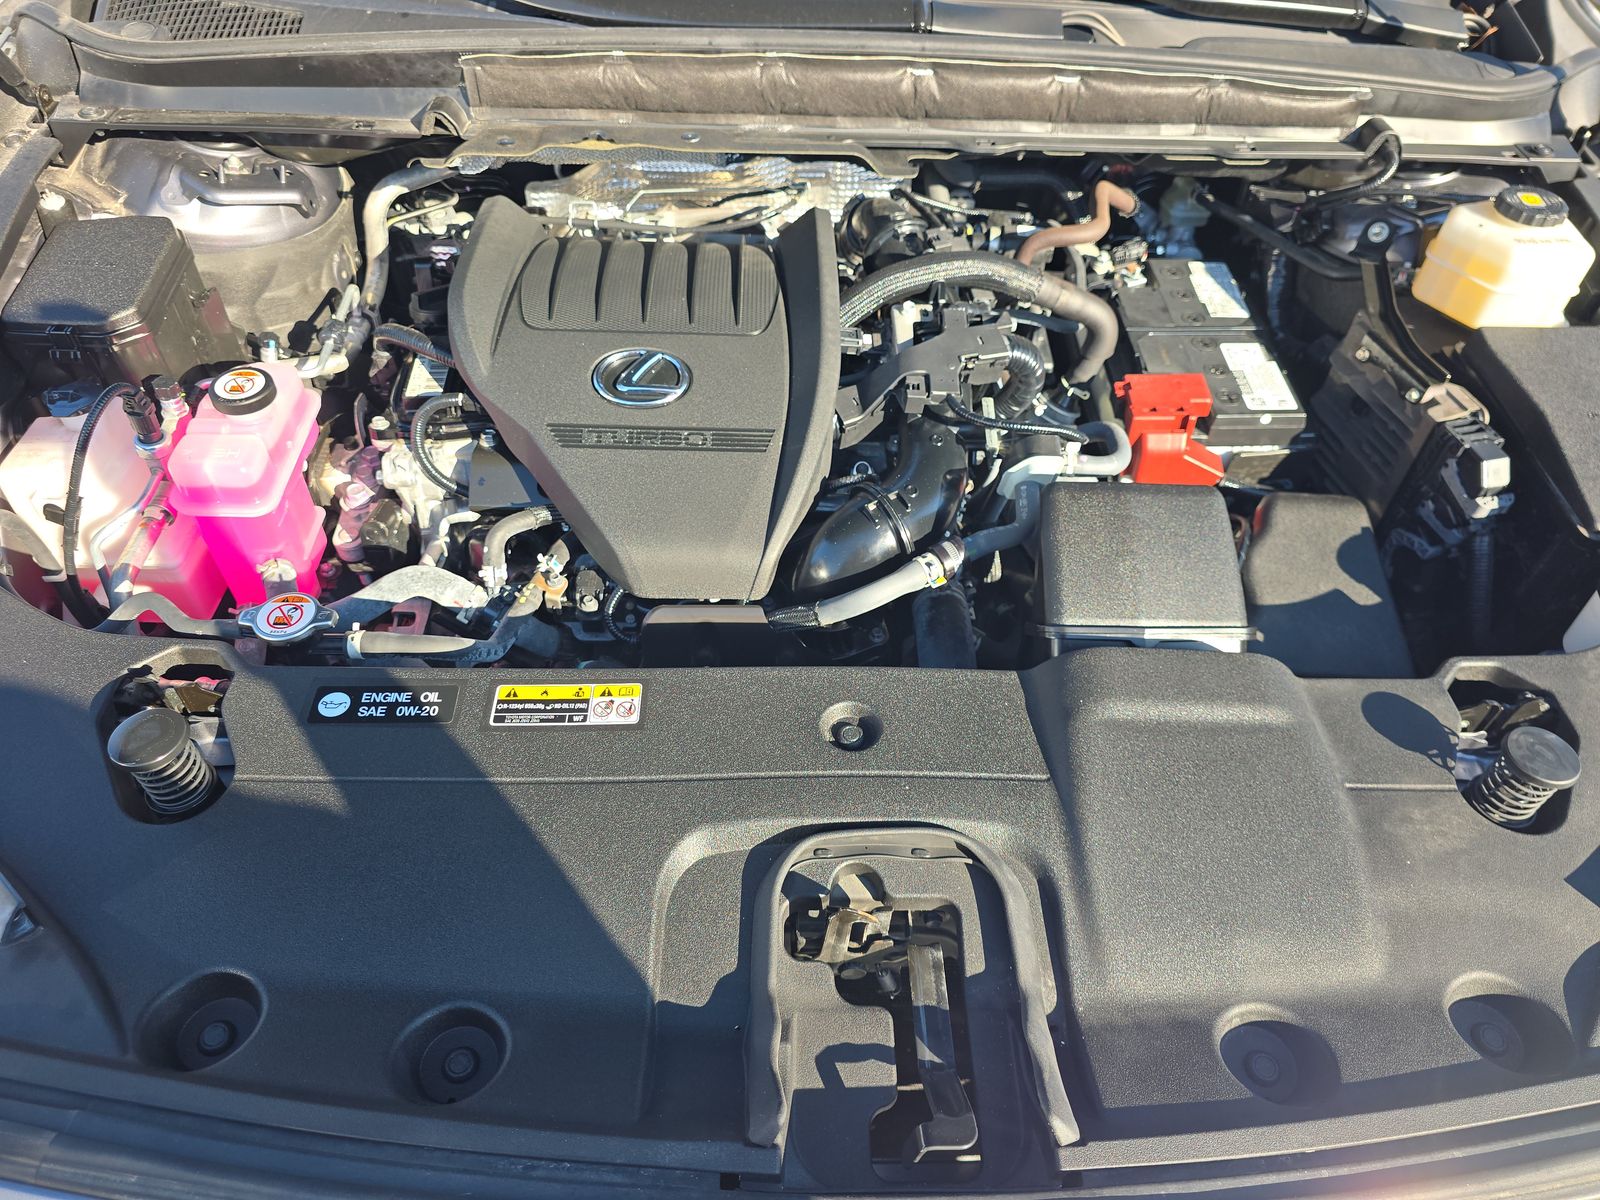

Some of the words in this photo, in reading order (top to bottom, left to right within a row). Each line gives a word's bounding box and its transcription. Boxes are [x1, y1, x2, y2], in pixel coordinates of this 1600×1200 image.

[582, 429, 711, 448] TURBO
[361, 691, 412, 703] ENGINE
[420, 691, 442, 703] OIL
[357, 706, 387, 717] SAE
[395, 705, 439, 717] 0W-20
